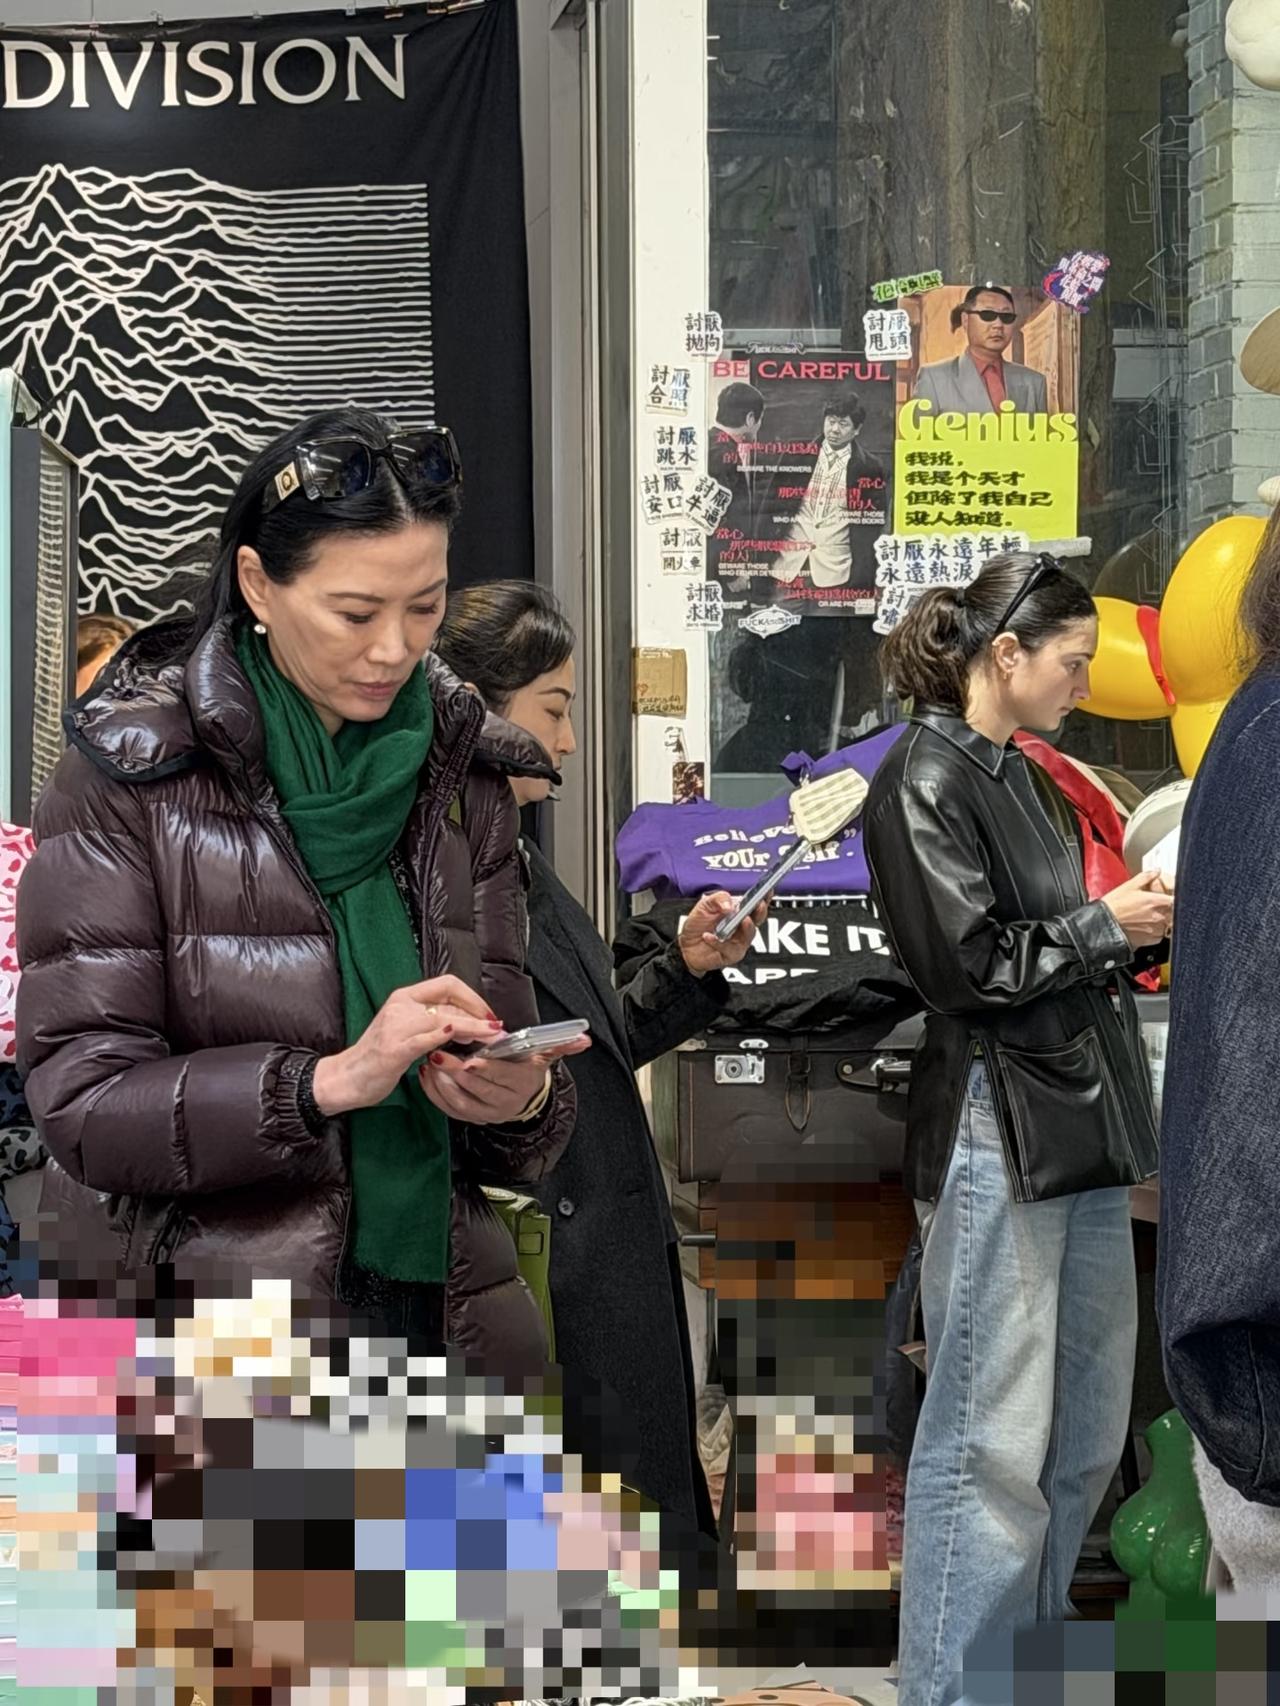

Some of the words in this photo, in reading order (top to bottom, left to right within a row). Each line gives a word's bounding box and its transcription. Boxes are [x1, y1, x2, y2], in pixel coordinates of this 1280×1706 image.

[1, 34, 409, 109] DIVISION
[713, 360, 749, 378] BE
[758, 360, 890, 381] CAREFUL
[899, 398, 1079, 442] Genius
[656, 446, 699, 466] 跳水
[904, 470, 1025, 486] 我是个天才
[904, 491, 1053, 507] 但除了我自己
